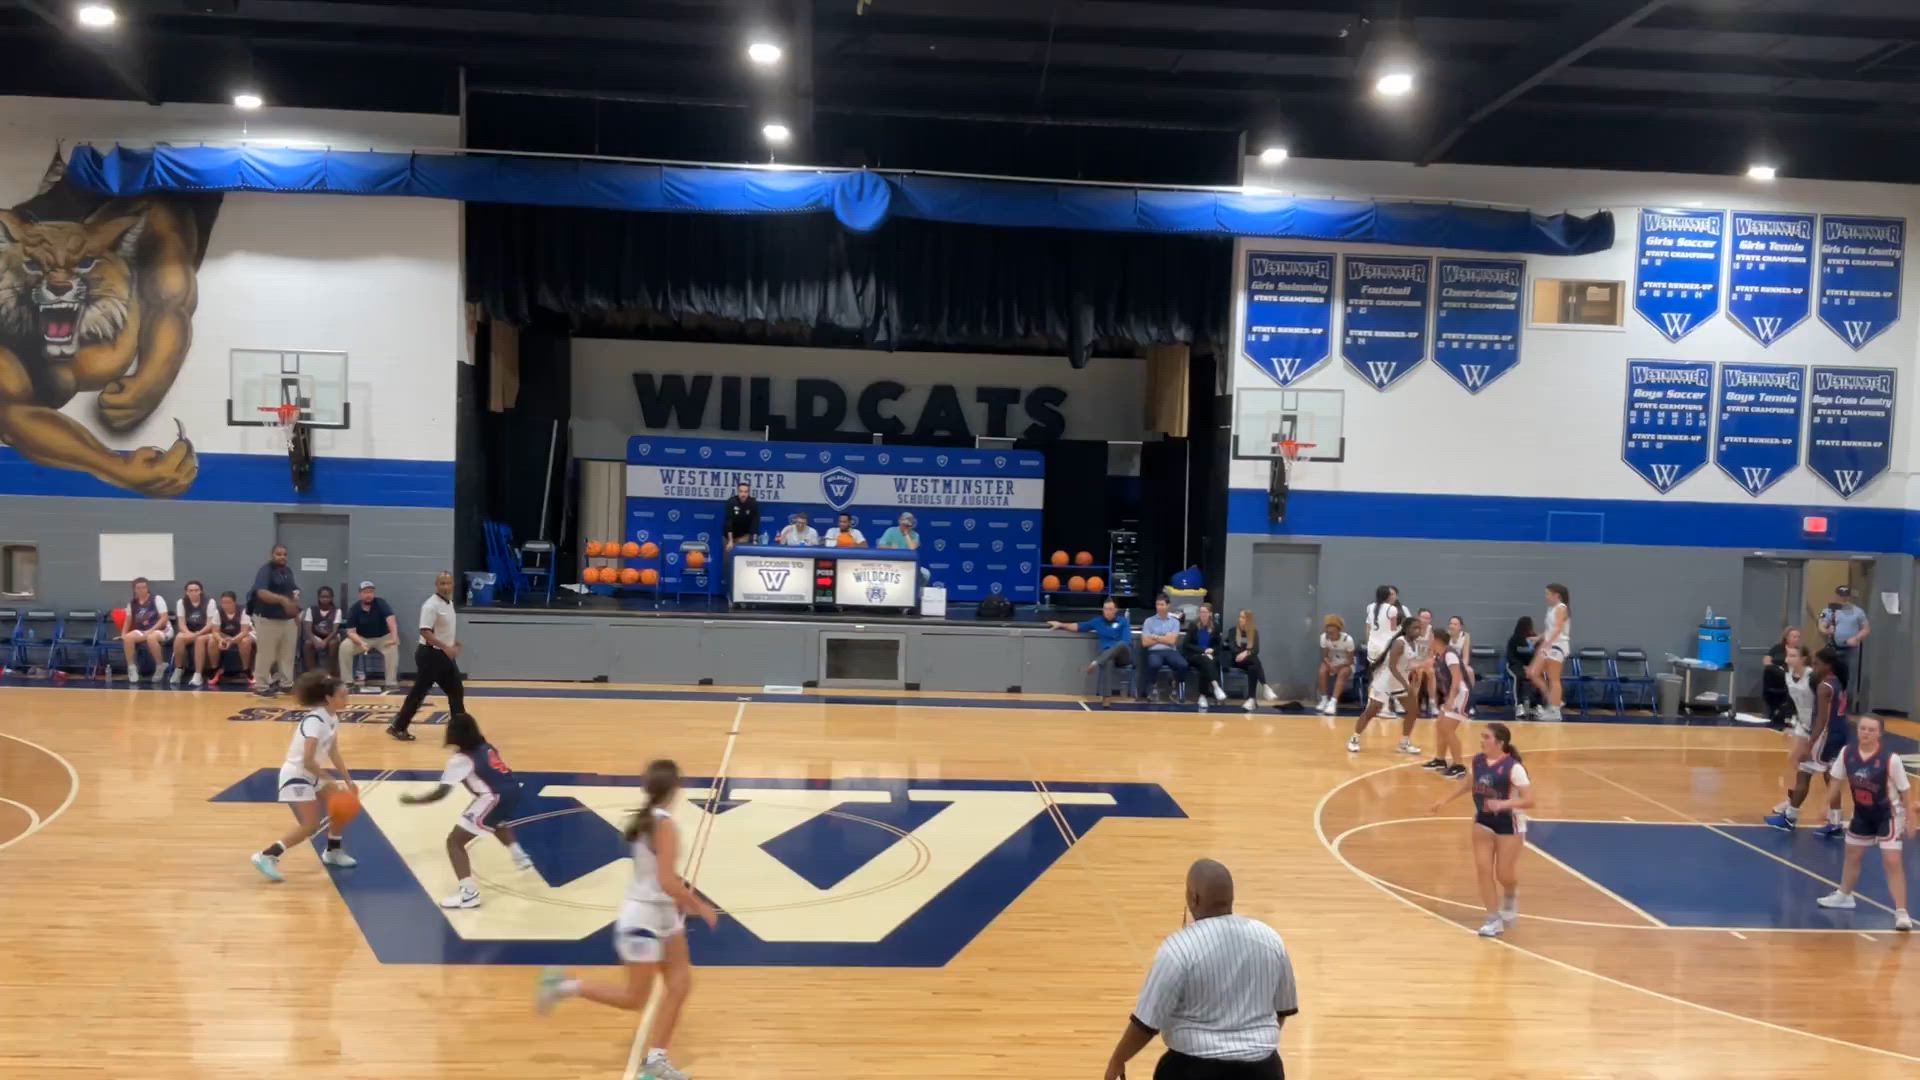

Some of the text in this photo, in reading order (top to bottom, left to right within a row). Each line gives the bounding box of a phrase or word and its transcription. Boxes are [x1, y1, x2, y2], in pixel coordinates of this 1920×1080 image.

[1644, 214, 1720, 236] WESTMINSTER
[1736, 218, 1811, 240] WESTMINSTER
[1826, 222, 1900, 244] WESTMINSTER
[1646, 236, 1717, 248] Girls Soccer
[1739, 240, 1804, 253] Girls Tennis
[1822, 244, 1841, 254] Girls
[1645, 250, 1715, 260] STATE CHAMPIONS
[1736, 254, 1807, 264] STATE CHAMPIONS
[1252, 258, 1330, 280] WESTMINSTER
[1348, 262, 1426, 283] WESTMINSTER
[1442, 266, 1520, 287] WESTMINSTER
[1360, 284, 1412, 296] Football
[1668, 282, 1714, 290] RUNNER-UP
[1760, 286, 1804, 294] RUNNER-UP
[1661, 312, 1692, 338] W
[1752, 316, 1783, 341] W
[1842, 320, 1872, 344] W
[1270, 358, 1302, 381] W
[1366, 361, 1397, 385] W
[1460, 364, 1490, 388] W
[1632, 366, 1708, 387] WESTMINSTER
[1725, 370, 1800, 391] WESTMINSTER
[1816, 373, 1890, 394] WESTMINSTER
[1633, 388, 1706, 400] Boys Soccer
[1726, 392, 1798, 404] Boys Tennis
[1812, 394, 1892, 408] Boys Cross Country
[632, 372, 1069, 441] WILDCATS
[1634, 402, 1704, 411] STATE CHAMPIONS
[1750, 406, 1795, 414] CHAMPIONS
[1816, 408, 1842, 416] STATE
[1656, 434, 1702, 442] RUNNER-UP
[1724, 436, 1793, 445] STATE RUNNER-UP
[659, 468, 786, 489] WESTMINSTER
[1650, 464, 1681, 489] W
[1742, 467, 1771, 492] W
[1834, 470, 1864, 495] W
[664, 486, 780, 500] SCHOOLS OF AUSTA
[830, 484, 848, 497] W
[894, 477, 1015, 496] WESTMINSTER
[898, 494, 1009, 507] SCHOOLS OF AUGUSTA
[746, 560, 790, 569] WELCOME
[758, 570, 790, 592] W
[852, 570, 902, 584] WILDCATS
